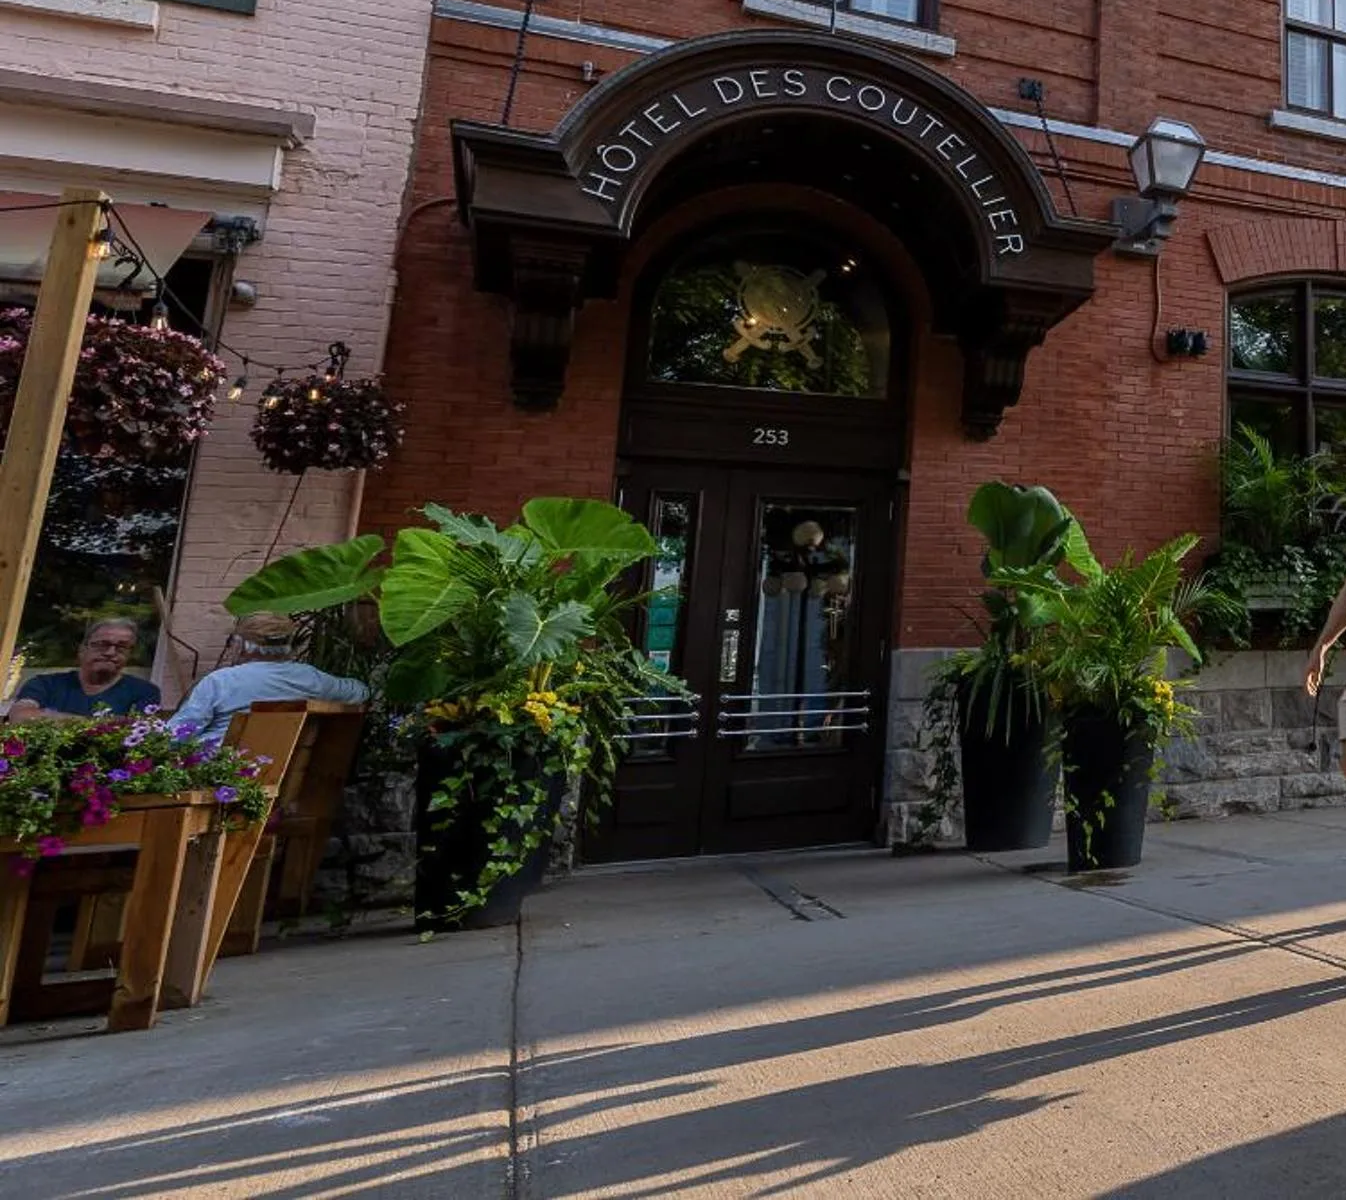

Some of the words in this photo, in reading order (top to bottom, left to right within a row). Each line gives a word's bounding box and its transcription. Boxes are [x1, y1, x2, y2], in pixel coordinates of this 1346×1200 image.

[582, 95, 707, 201] HÔTEL
[713, 70, 807, 104] DES
[826, 75, 1024, 255] COUTELLIER
[753, 427, 790, 446] 253
